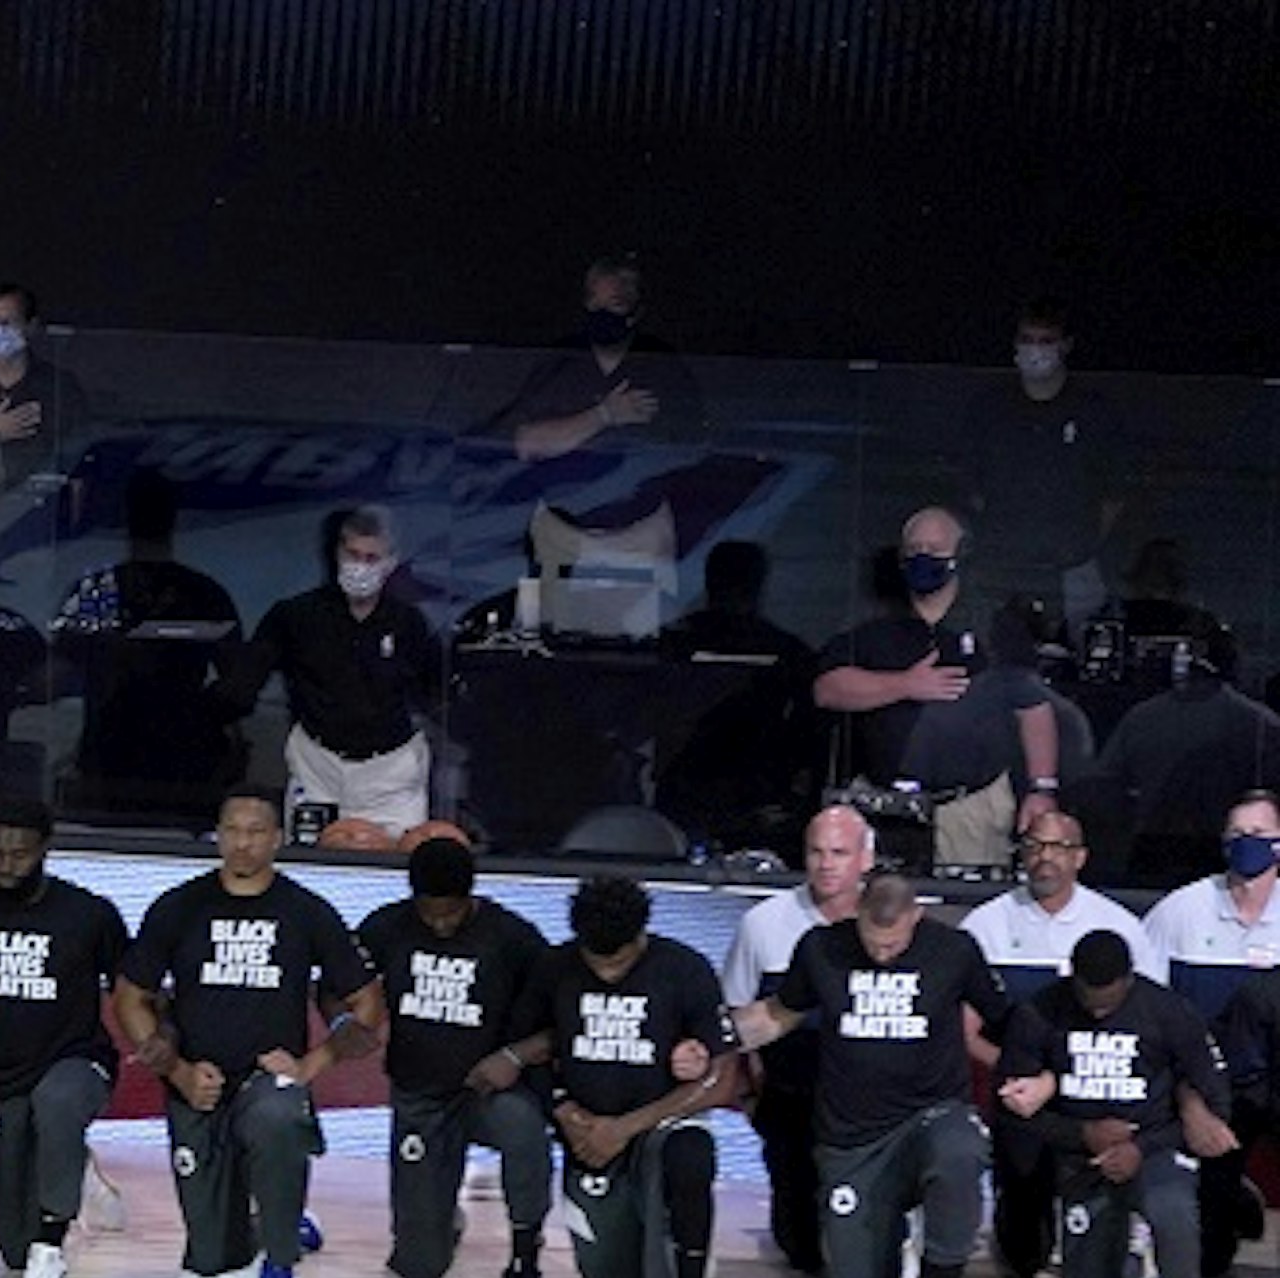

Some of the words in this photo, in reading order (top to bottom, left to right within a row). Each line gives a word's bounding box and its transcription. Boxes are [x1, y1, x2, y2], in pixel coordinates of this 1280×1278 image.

[210, 919, 278, 946] BLACK
[215, 942, 272, 965] LIVES
[200, 962, 283, 989] MATTER
[410, 951, 478, 984] BLACK
[414, 976, 469, 1003] LIVES
[848, 970, 921, 996] BLACK
[399, 993, 483, 1027] MATTER
[579, 992, 649, 1020] BLACK
[854, 991, 913, 1016] LIVES
[586, 1015, 641, 1040] LIVES
[840, 1012, 928, 1039] MATTER
[571, 1035, 657, 1066] MATTER
[1067, 1031, 1140, 1058] BLACK
[1074, 1053, 1132, 1078] LIVES
[1060, 1073, 1148, 1100] MATTER
